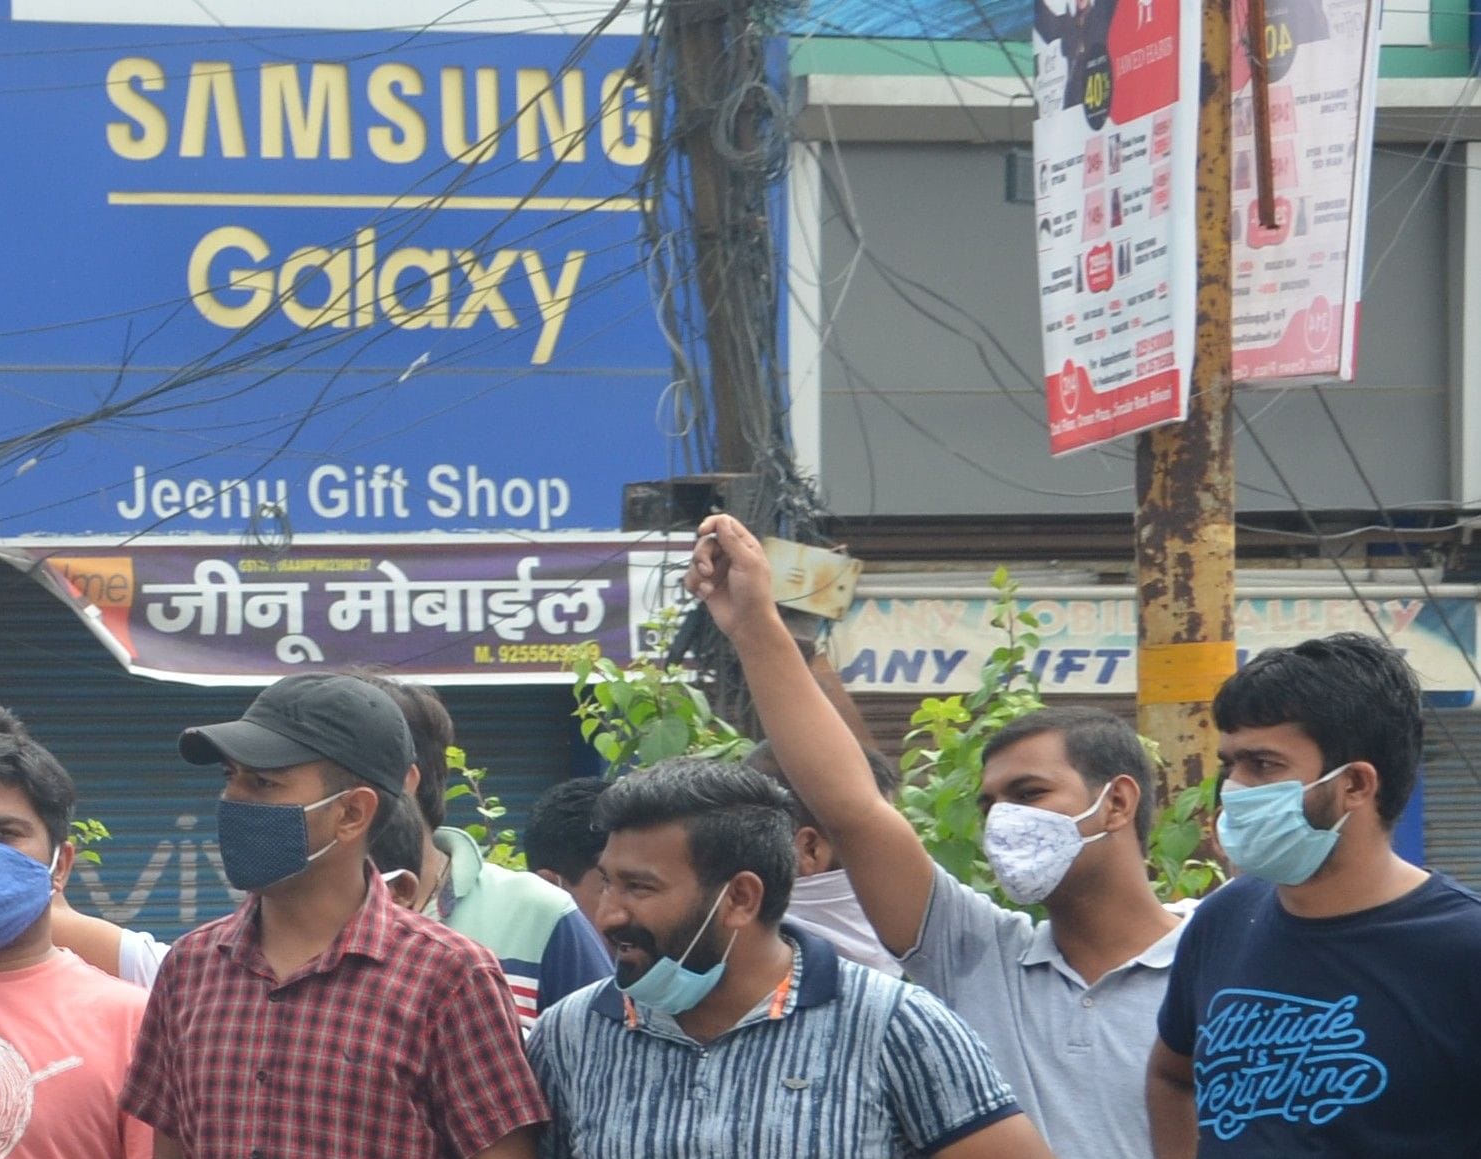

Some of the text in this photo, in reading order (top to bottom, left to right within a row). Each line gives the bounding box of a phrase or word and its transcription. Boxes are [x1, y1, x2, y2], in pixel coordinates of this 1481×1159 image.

[106, 57, 654, 167] SAMSUNG
[187, 225, 587, 365] Galaxy
[118, 463, 571, 530] Jeenu Gift Shop
[142, 556, 611, 664] जीनू मोबाईल
[1233, 599, 1425, 633] ALLERY
[840, 648, 969, 684] ANY
[1197, 988, 1366, 1056] Attitude
